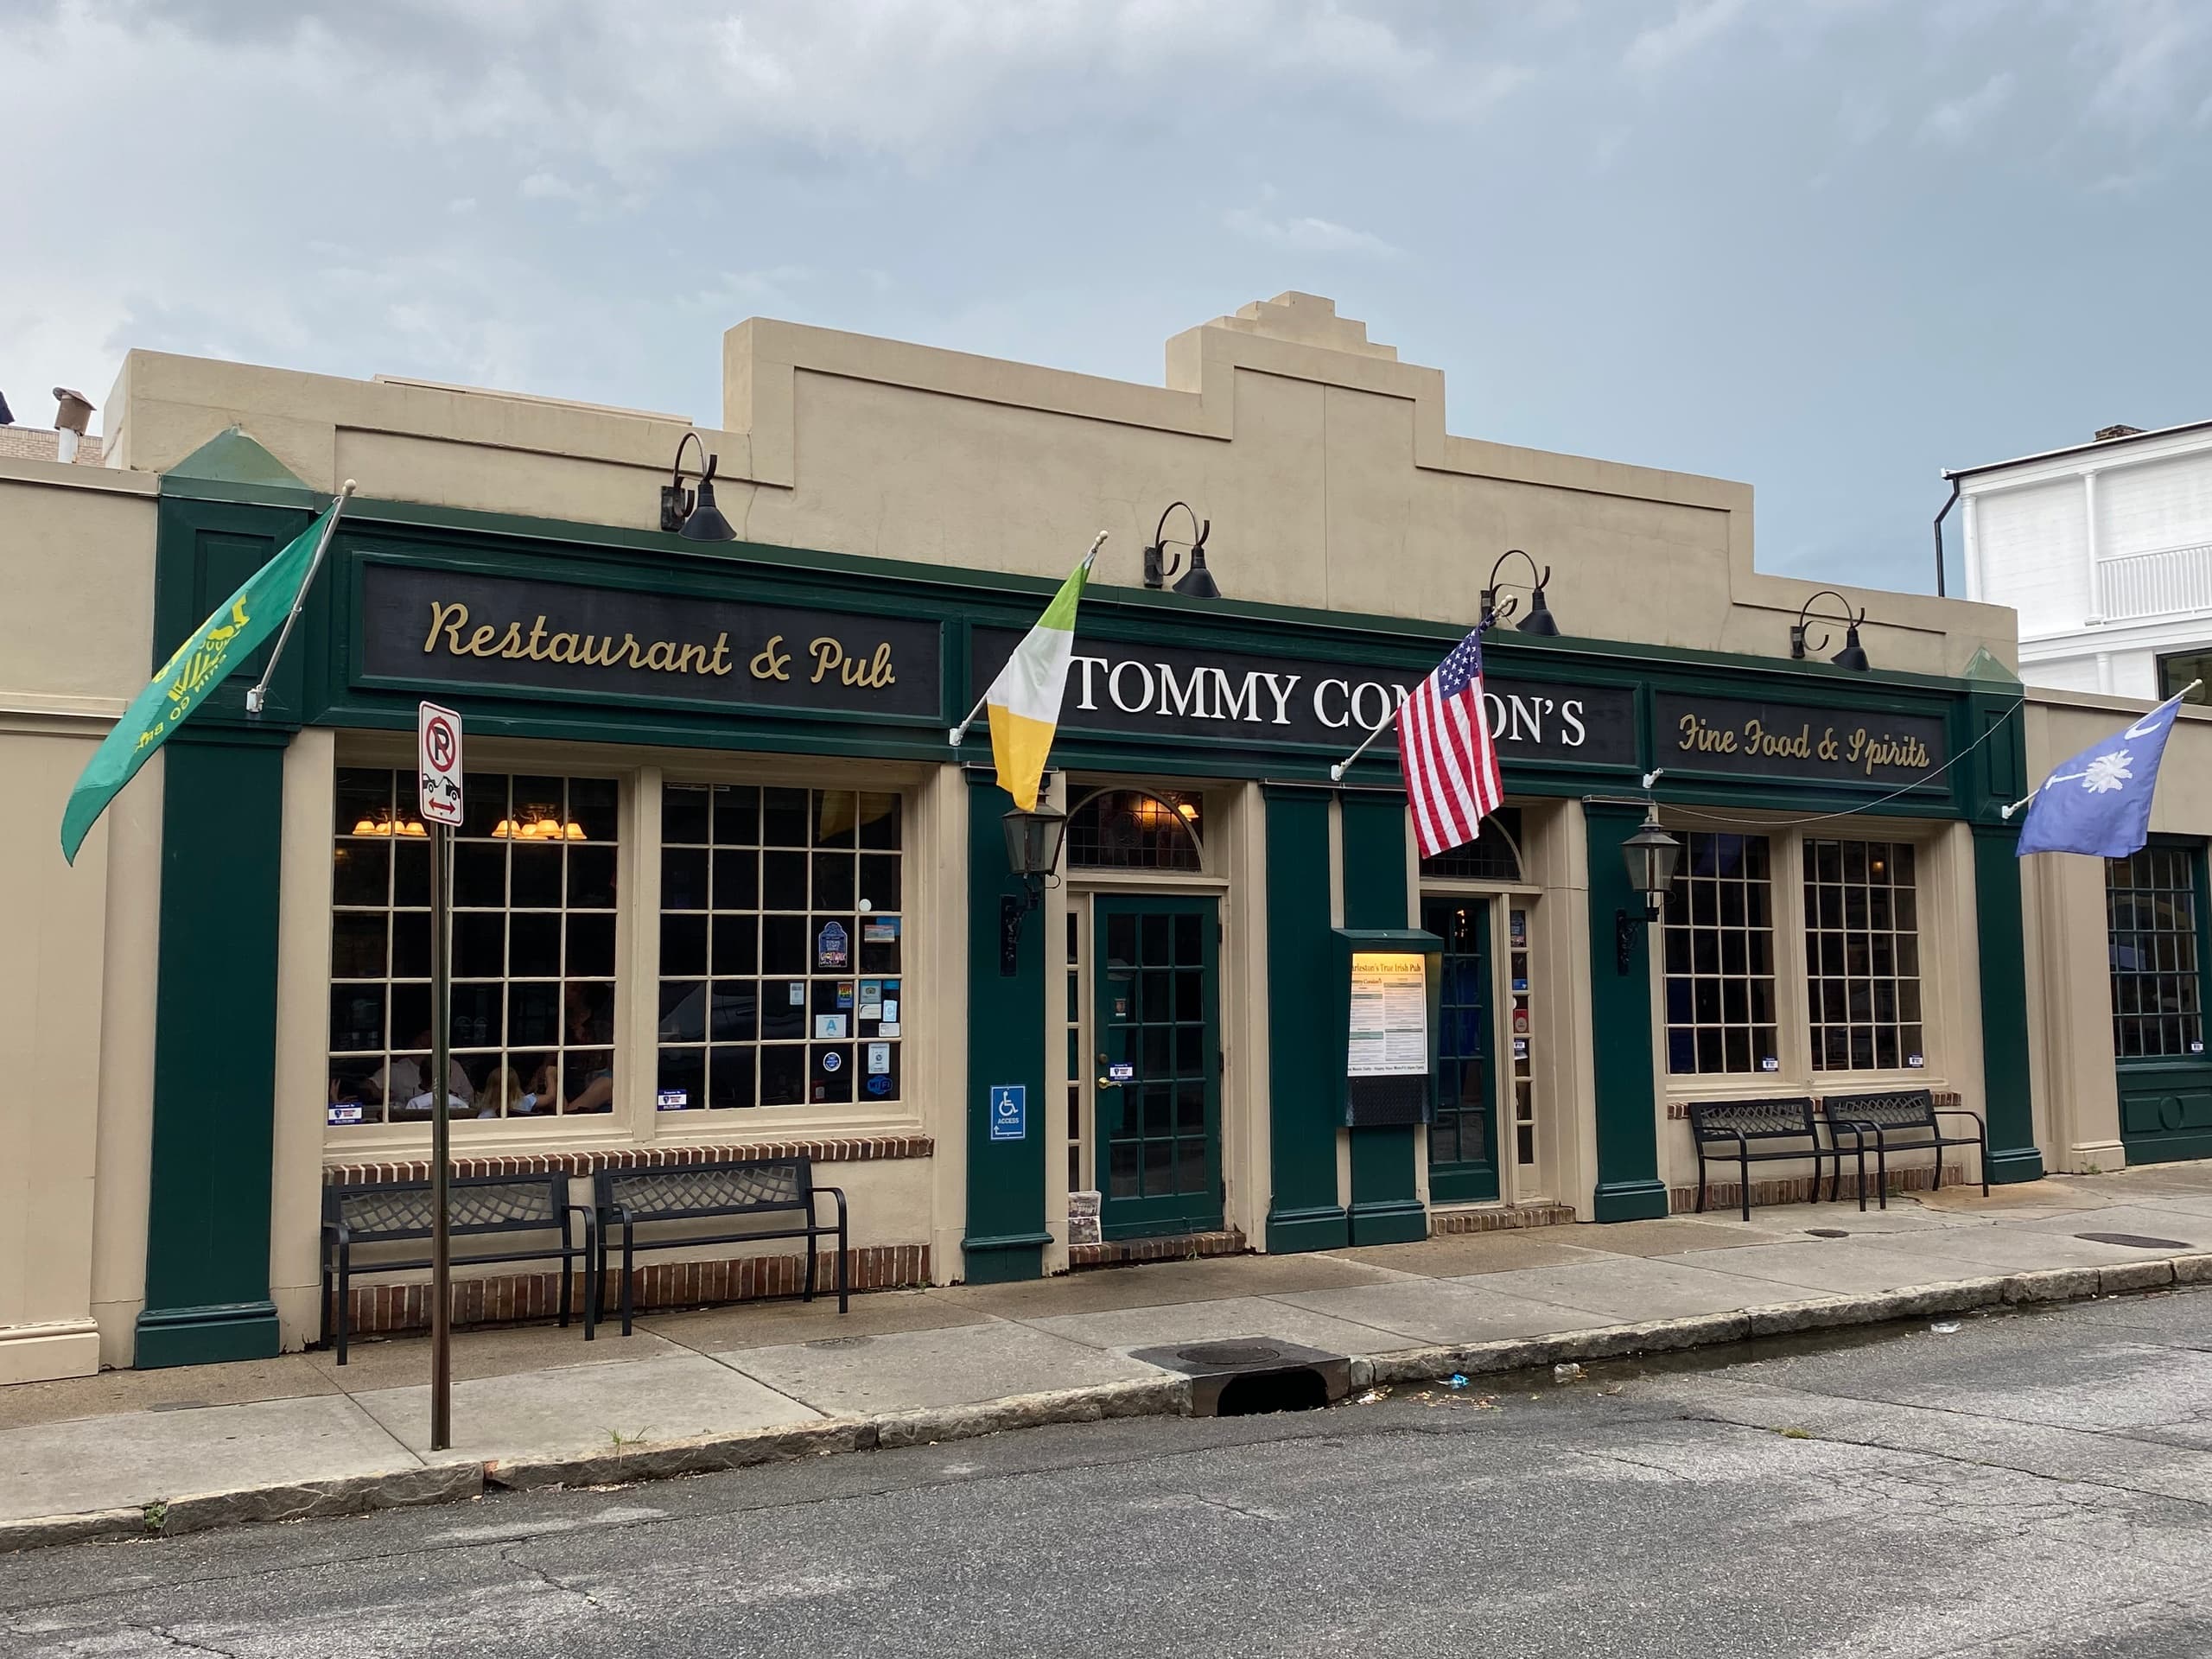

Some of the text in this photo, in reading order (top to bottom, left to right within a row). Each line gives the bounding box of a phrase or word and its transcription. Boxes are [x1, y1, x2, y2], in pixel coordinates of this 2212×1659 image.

[423, 601, 896, 689] Restaurant & Pub
[1070, 655, 1586, 747] TOMMY COON'S
[1679, 714, 1929, 775] Fine Food & Spirits
[1395, 963, 1408, 972] Irish
[1410, 963, 1421, 972] Pub
[826, 1020, 836, 1031] A
